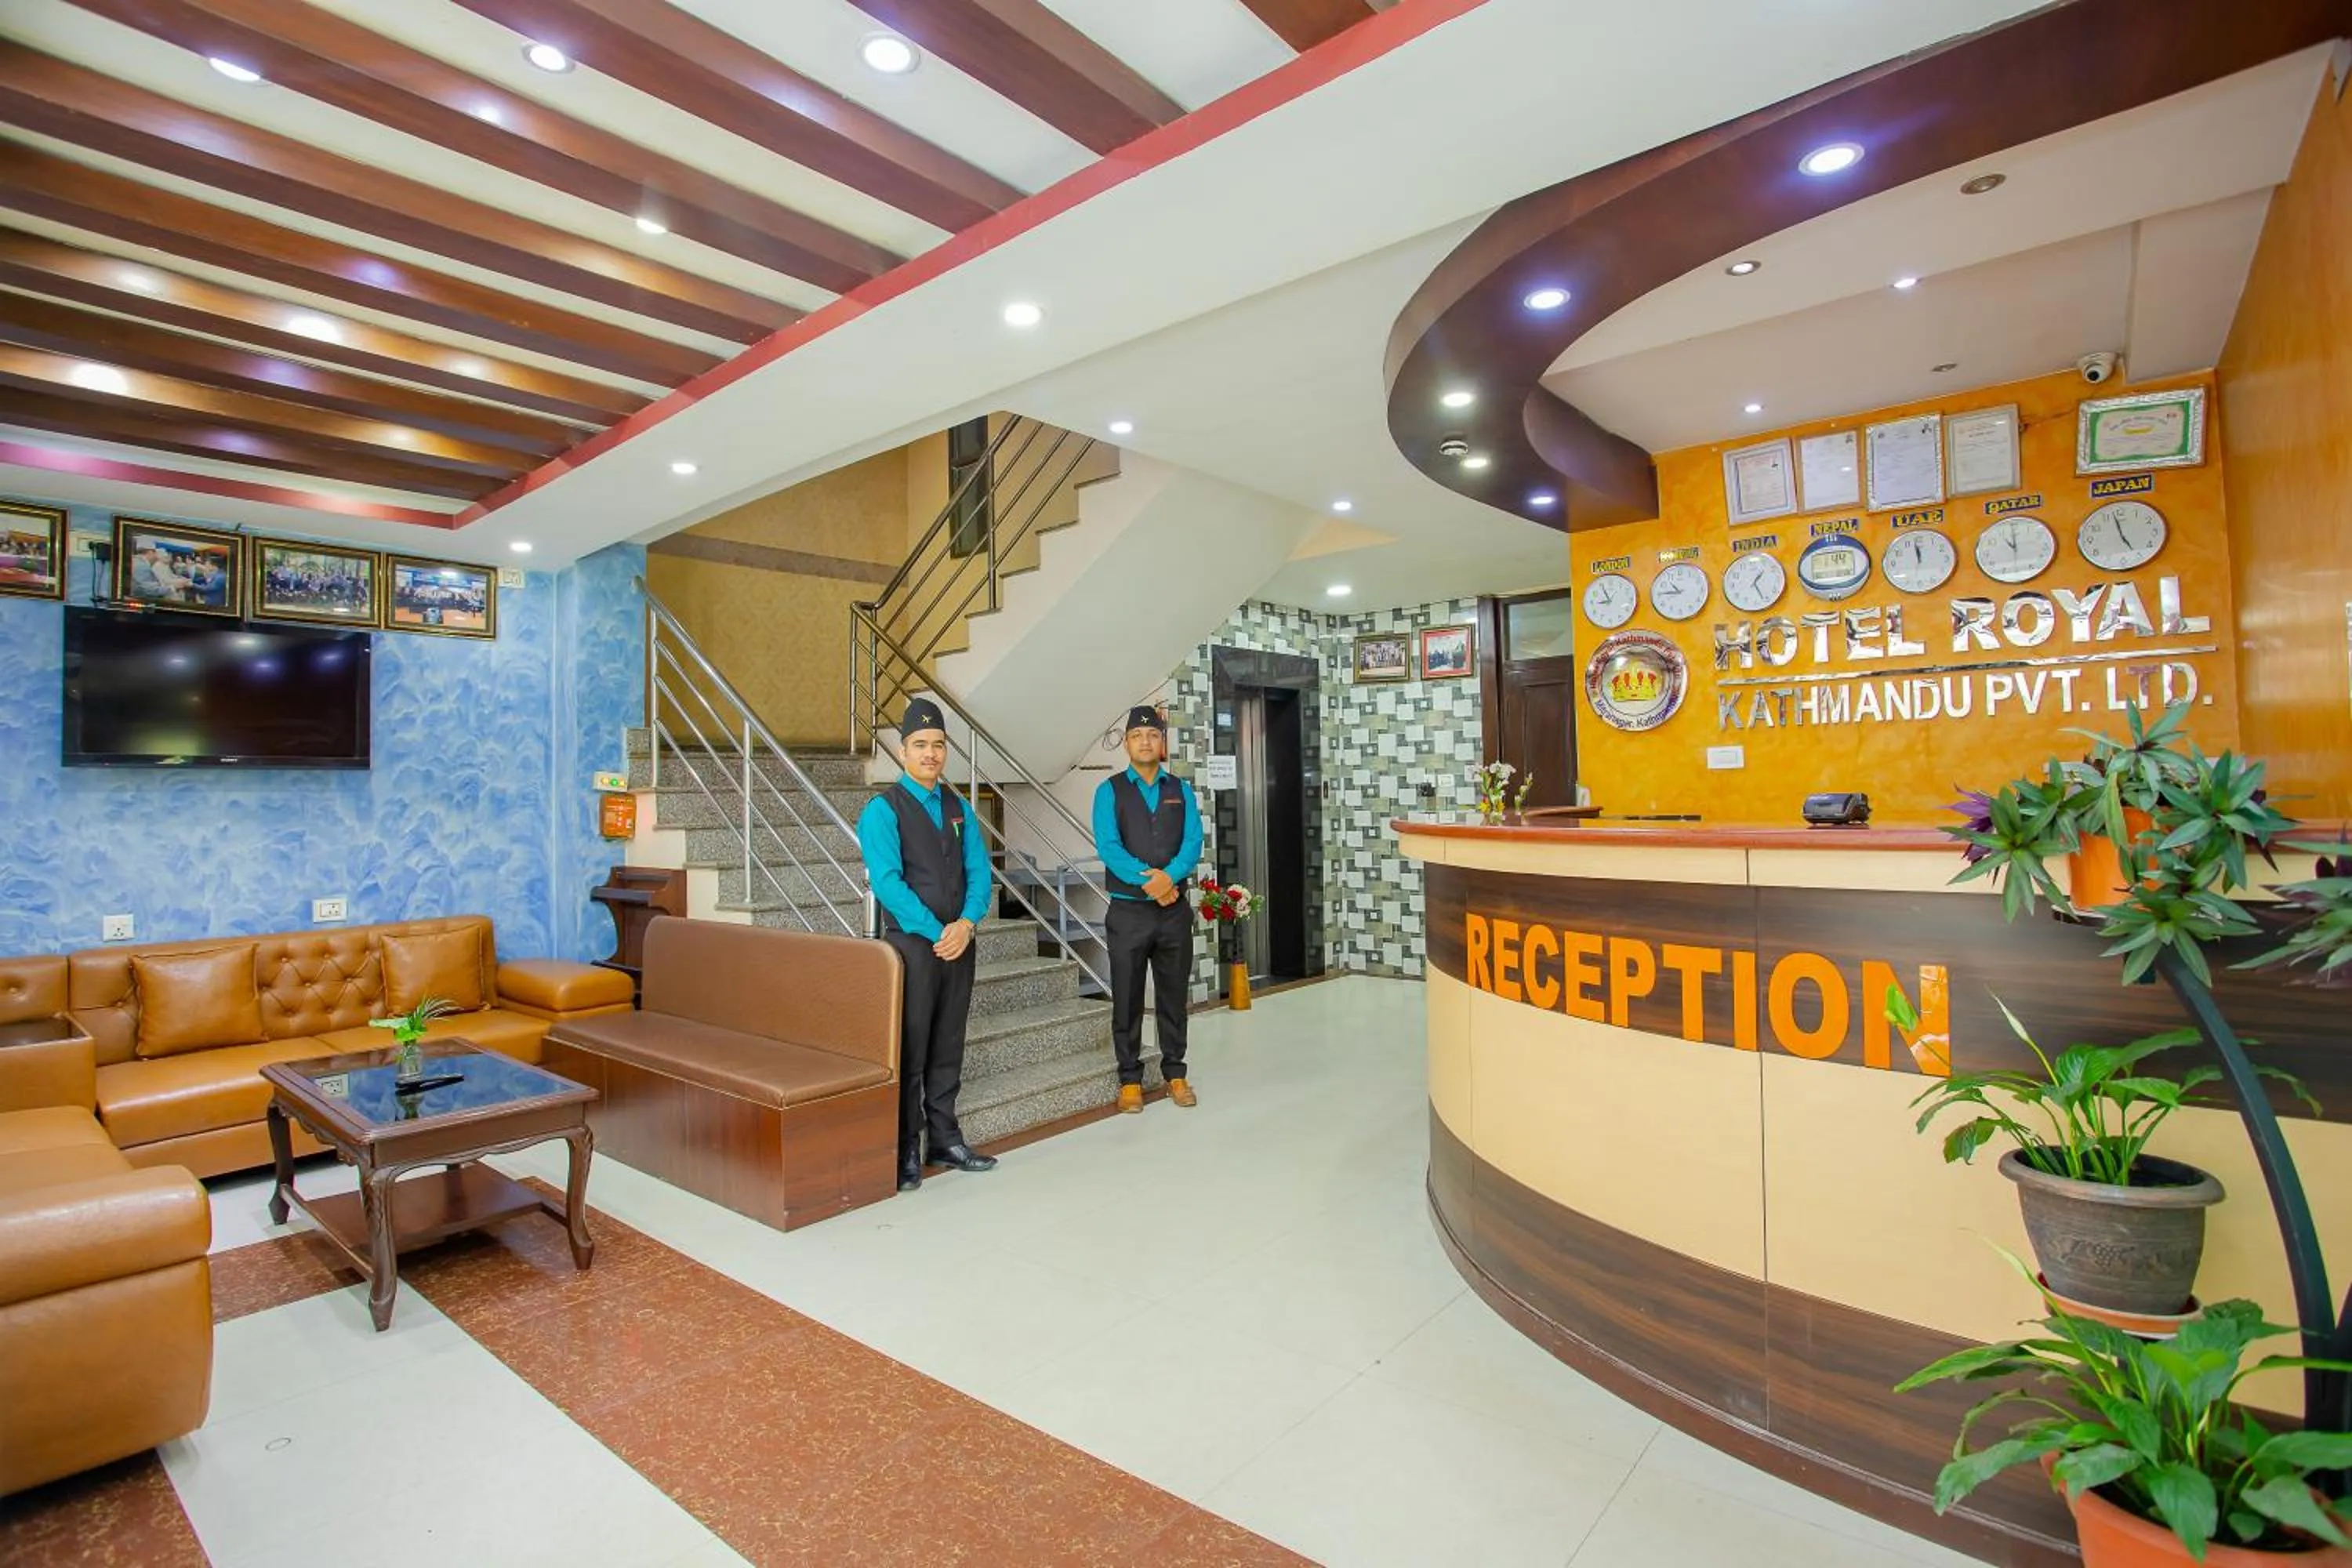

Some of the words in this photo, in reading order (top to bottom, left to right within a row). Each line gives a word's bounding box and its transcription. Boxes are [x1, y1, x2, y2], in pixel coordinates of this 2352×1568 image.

[2094, 477, 2151, 495] JAPAN
[1988, 496, 2040, 514] QATAR
[1813, 520, 1857, 534] NEPAL
[1896, 510, 1943, 526] UAE
[1734, 535, 1777, 552] INDIA
[1714, 604, 1926, 670] HOTEL
[1951, 576, 2211, 652] ROYAL
[1718, 673, 1972, 729] KATHMANDU
[1986, 668, 2091, 716] PVT.
[2107, 662, 2213, 710] LTD.
[1465, 912, 1952, 1078] RECEPTION
